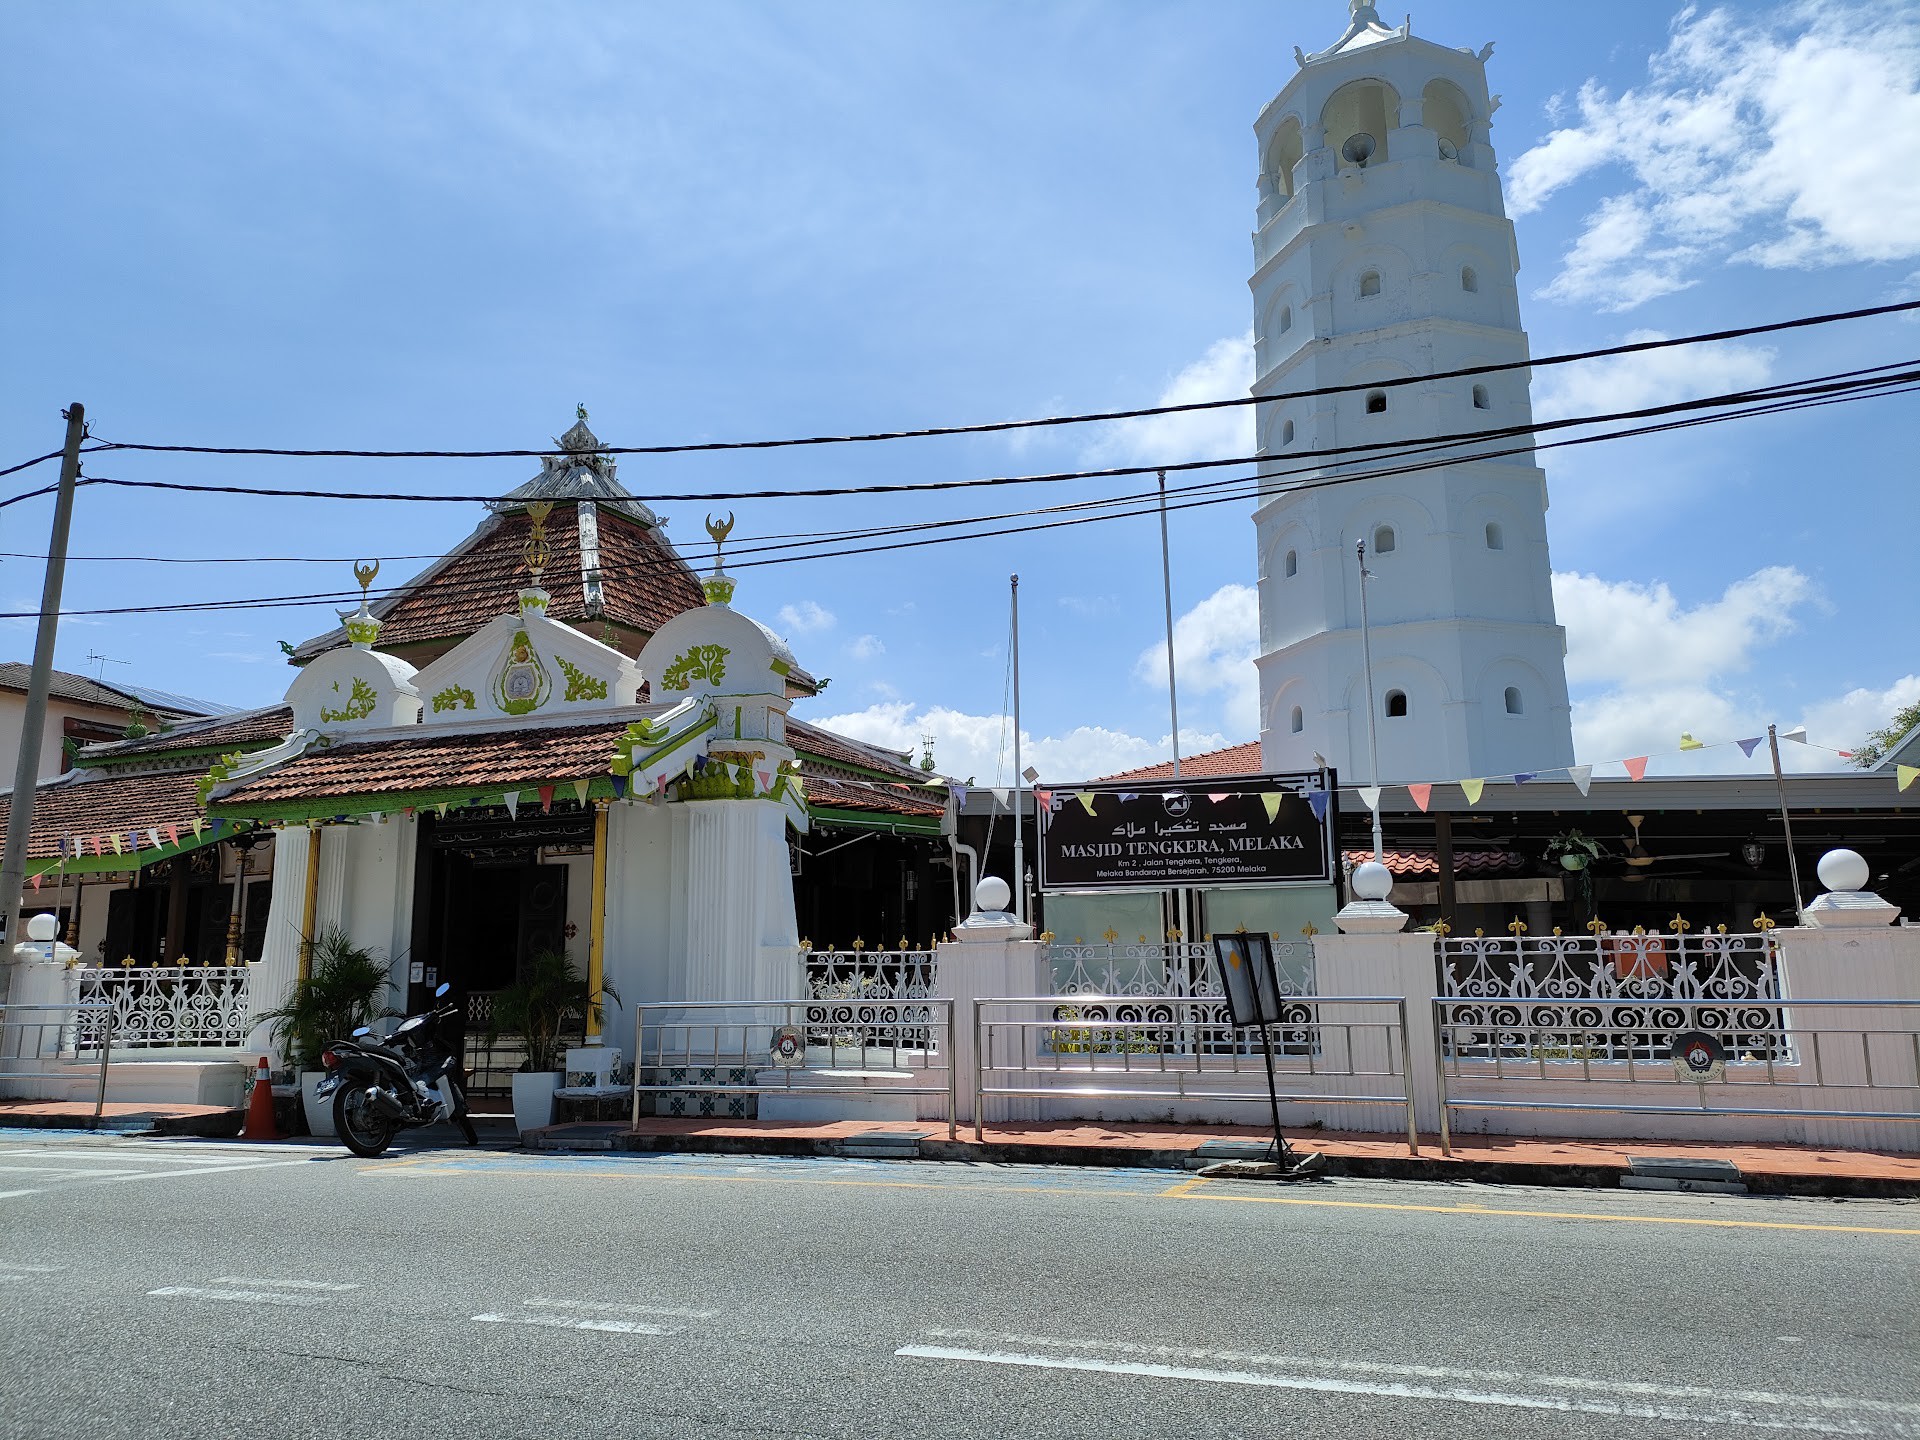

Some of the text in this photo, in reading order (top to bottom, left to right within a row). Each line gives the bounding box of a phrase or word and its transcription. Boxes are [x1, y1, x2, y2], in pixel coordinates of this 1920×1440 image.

[1208, 822, 1247, 835] مسجد
[1060, 835, 1305, 858] MASJID TENGKERA, MELAKA
[1117, 860, 1130, 868] Km
[1142, 859, 1164, 867] Jalan
[1165, 857, 1203, 868] Tengkera,
[1203, 856, 1243, 866] Tengkera,
[1096, 869, 1124, 878] Melaka
[1125, 868, 1166, 878] Bandaraya
[1211, 866, 1236, 874] 75200
[1237, 865, 1267, 873] Melaka
